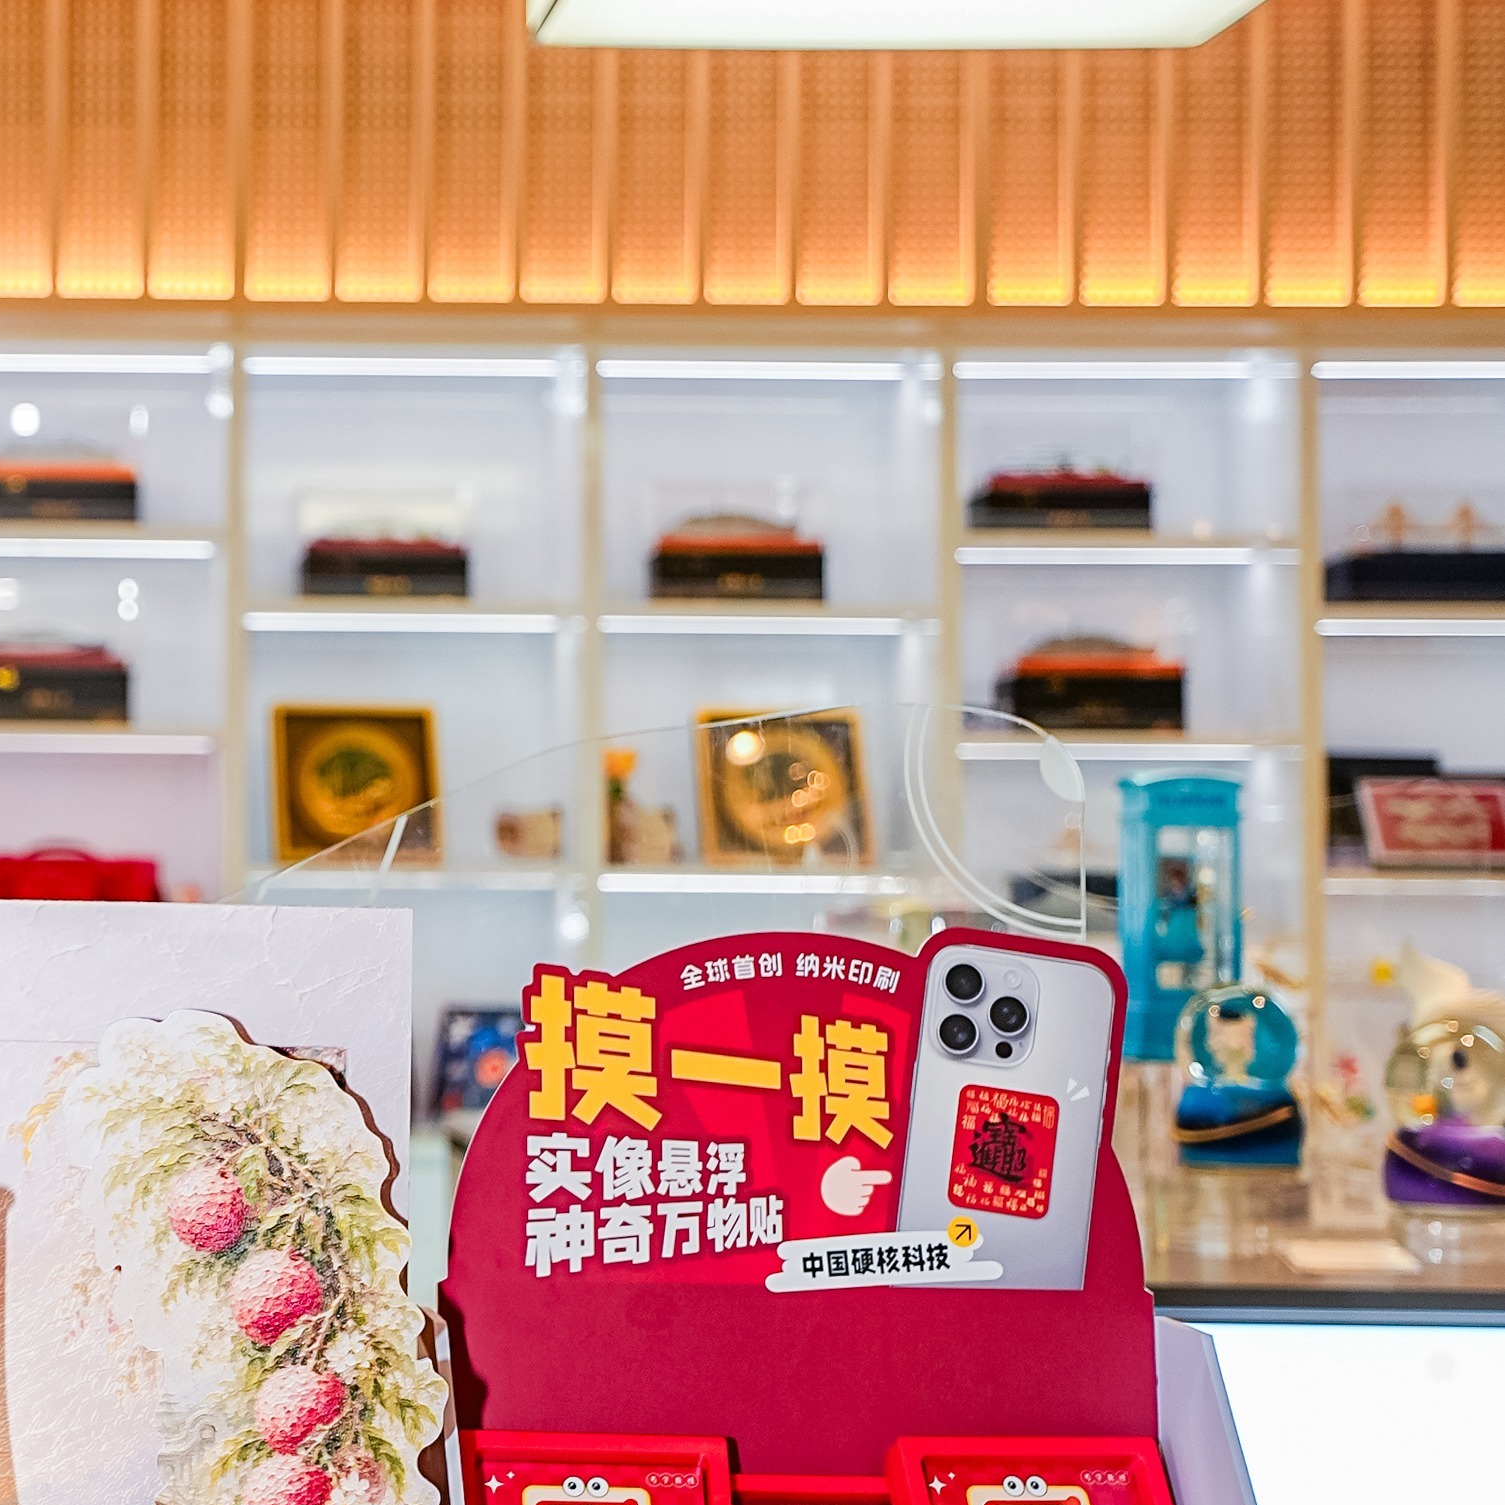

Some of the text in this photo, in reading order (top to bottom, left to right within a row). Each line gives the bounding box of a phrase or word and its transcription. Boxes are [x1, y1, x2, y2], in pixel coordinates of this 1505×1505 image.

[680, 952, 901, 995] 全球首创 纳米印刷
[525, 973, 894, 1151] 摸一摸
[524, 1133, 747, 1203] 实像悬浮
[524, 1194, 784, 1279] 神奇万物贴
[802, 1242, 952, 1280] 中国硬核科技
